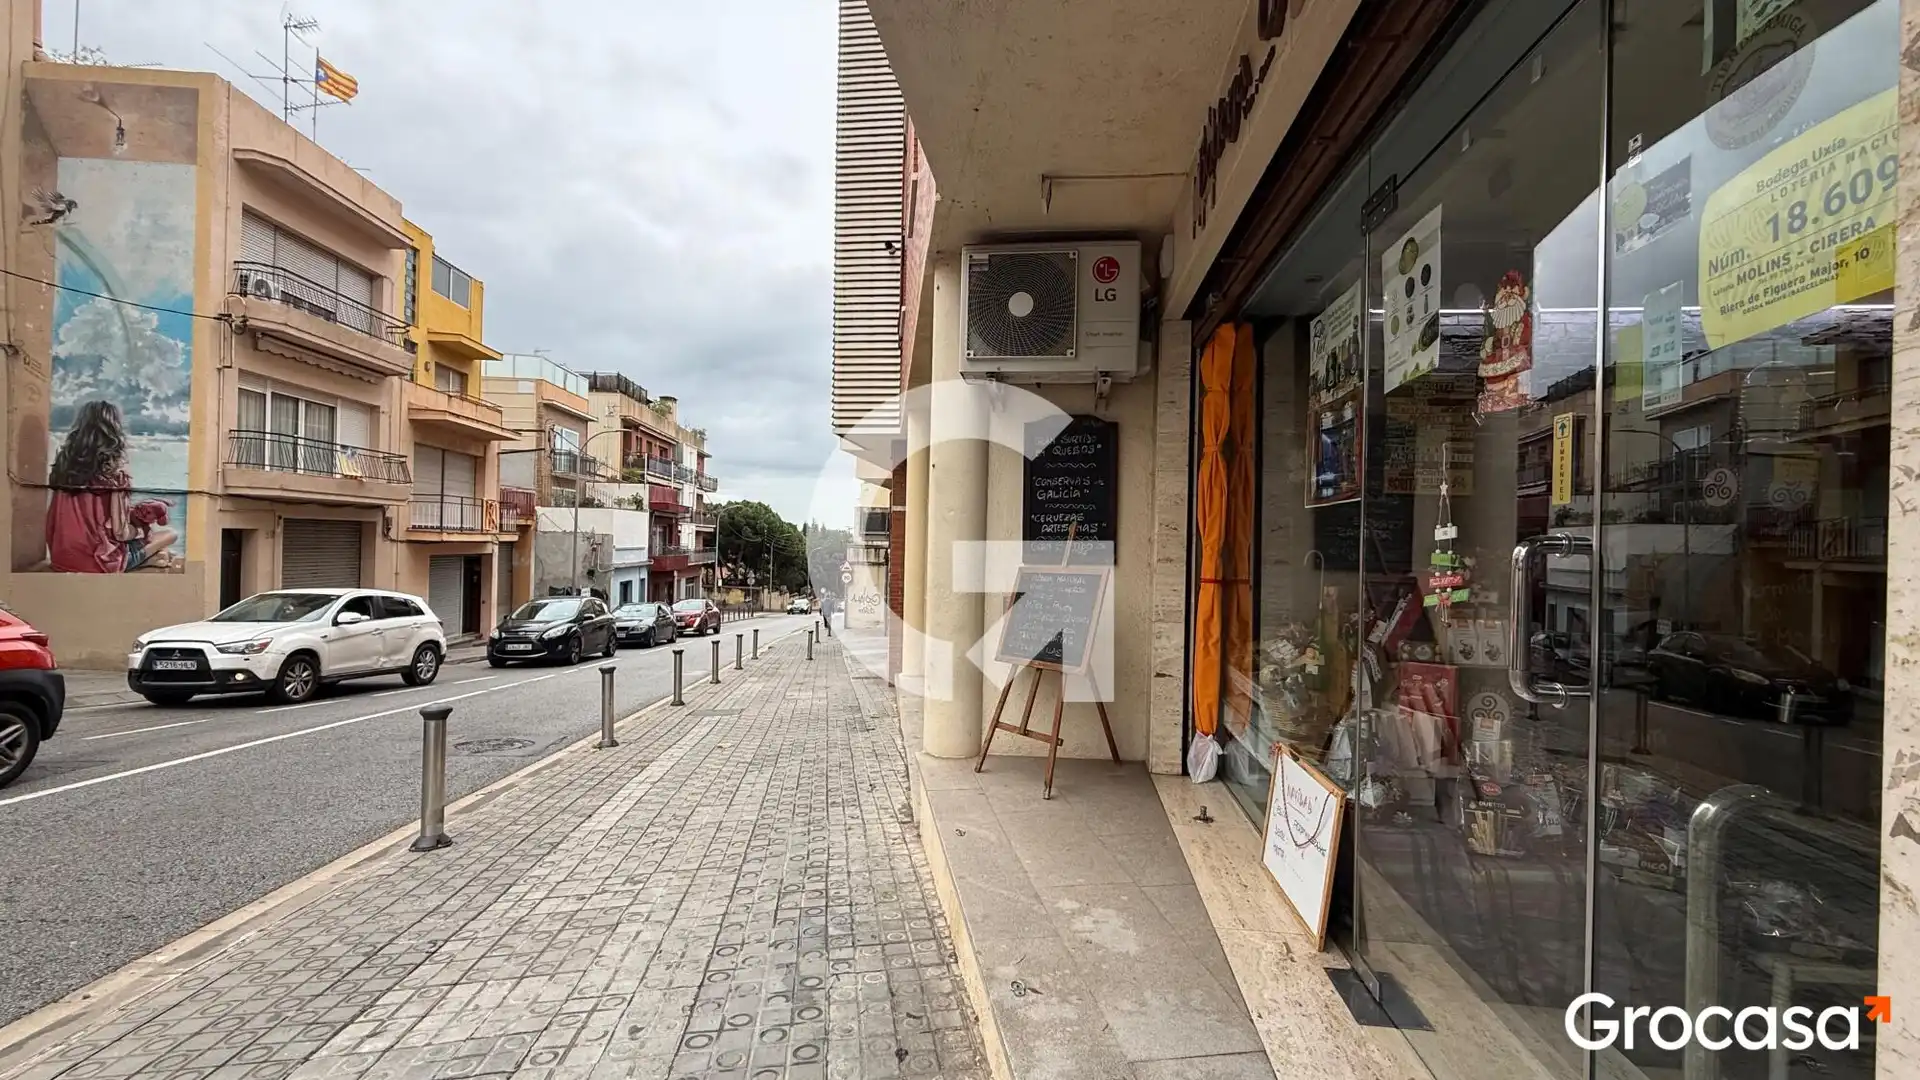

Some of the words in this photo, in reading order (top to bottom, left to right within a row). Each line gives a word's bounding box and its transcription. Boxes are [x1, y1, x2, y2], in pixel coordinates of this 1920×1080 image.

[1756, 158, 1809, 194] Bodega
[1811, 136, 1847, 161] Uxía
[1770, 161, 1837, 204] LOTERIA
[1707, 247, 1752, 277] Núm.
[1766, 153, 1899, 244] 18.609
[1720, 299, 1746, 316] Riera
[1747, 291, 1760, 305] de
[1762, 273, 1806, 298] Figuera
[1809, 257, 1850, 279] Major,
[1853, 247, 1871, 262] 10
[1736, 251, 1792, 286] MOLINS
[1809, 215, 1876, 255] CIRERA
[1094, 287, 1117, 303] LG
